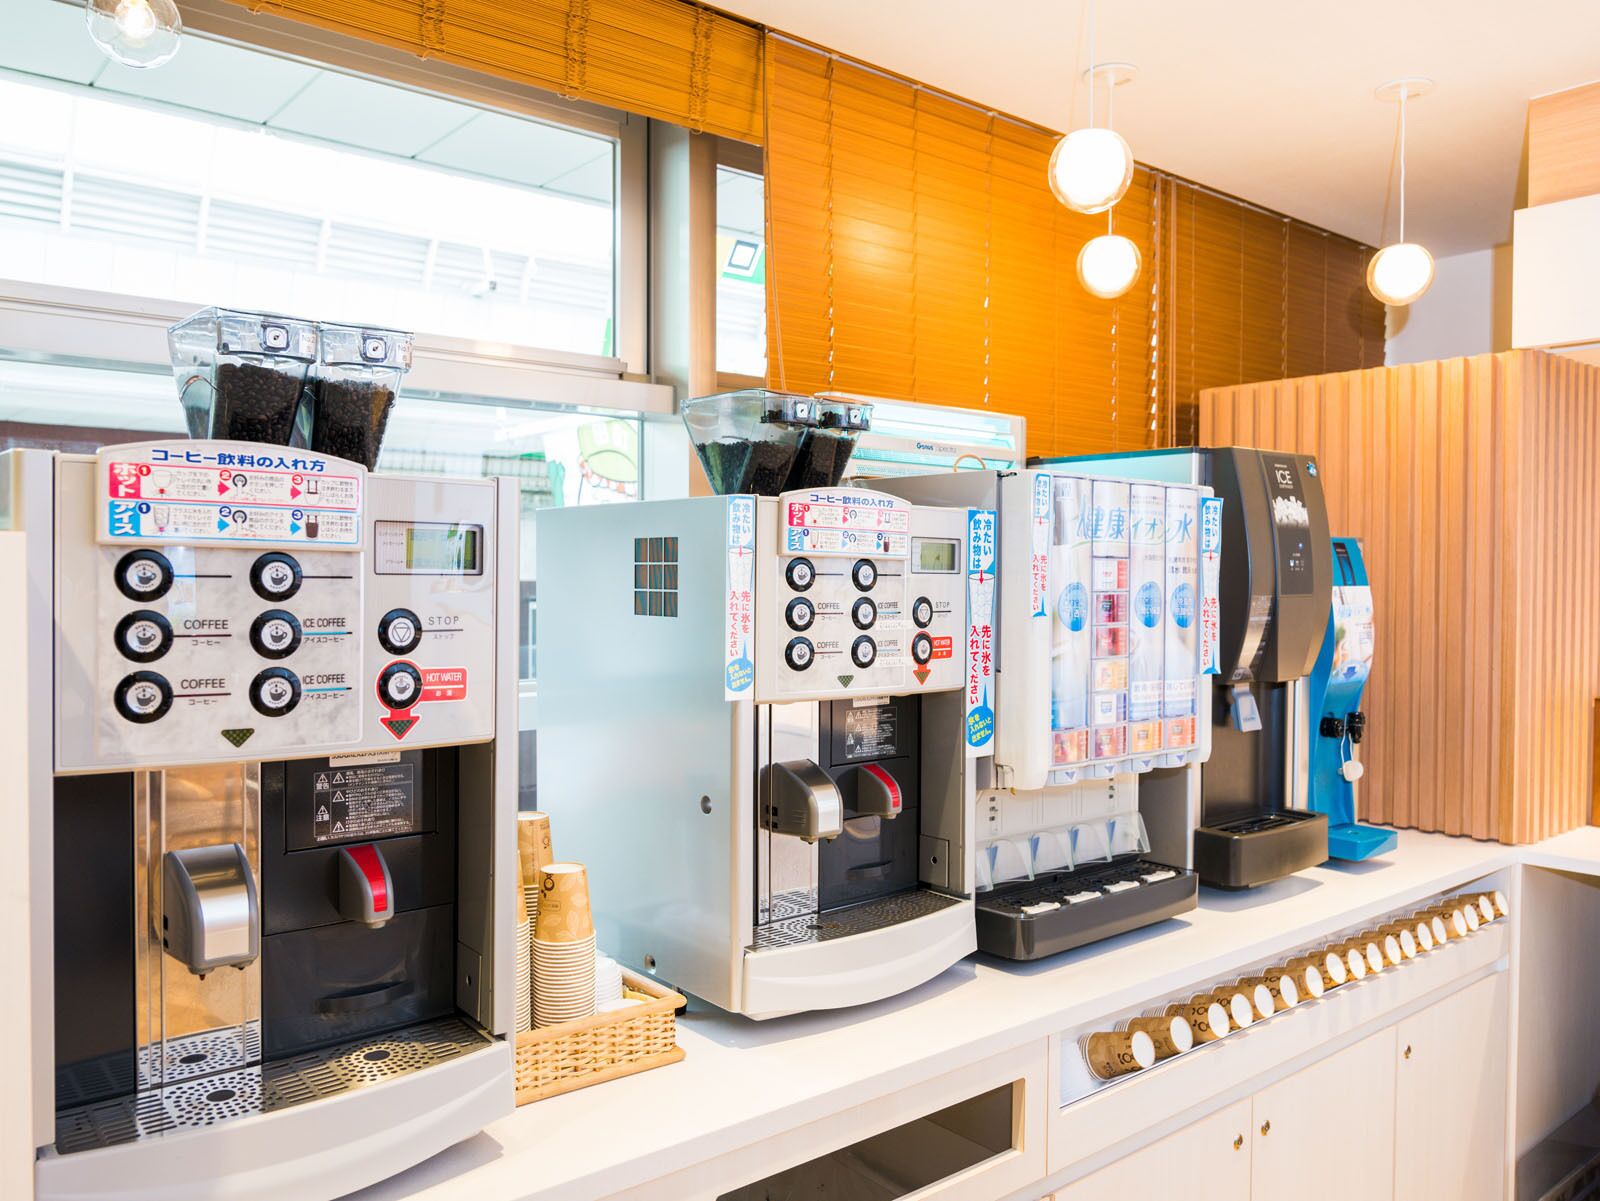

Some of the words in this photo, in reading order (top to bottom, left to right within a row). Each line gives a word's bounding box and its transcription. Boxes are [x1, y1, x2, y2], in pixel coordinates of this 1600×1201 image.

[151, 449, 326, 473] コーヒー飲料の入れ方
[113, 463, 137, 497] ホット
[1275, 470, 1293, 484] ICE
[810, 494, 895, 509] コーヒー飲料の入れ方
[113, 501, 137, 536] アイス
[732, 502, 741, 545] 飲み物は
[743, 502, 751, 534] 冷たい
[791, 504, 803, 525] ホット
[791, 529, 804, 550] アイス
[972, 517, 982, 570] 飲み物は
[983, 517, 992, 556] 冷たい
[741, 590, 751, 635] 先に氷を
[818, 602, 840, 610] COFFEE
[184, 620, 229, 630] COFFEE
[303, 618, 315, 628] ICE
[317, 617, 346, 628] COFFEE
[428, 616, 460, 626] STOP
[730, 590, 739, 657] 入れてください
[191, 639, 221, 647] コーヒー
[303, 636, 345, 644] アイスコーヒー
[817, 641, 840, 649] COFFEE
[981, 624, 992, 677] 先に氷を
[970, 624, 980, 705] 入れてください
[181, 679, 226, 689] COFFEE
[303, 674, 315, 685] ICE
[316, 674, 345, 684] COFFEE
[426, 673, 439, 682] HOT
[440, 672, 462, 682] WATER
[303, 692, 345, 700] アイスコーヒー
